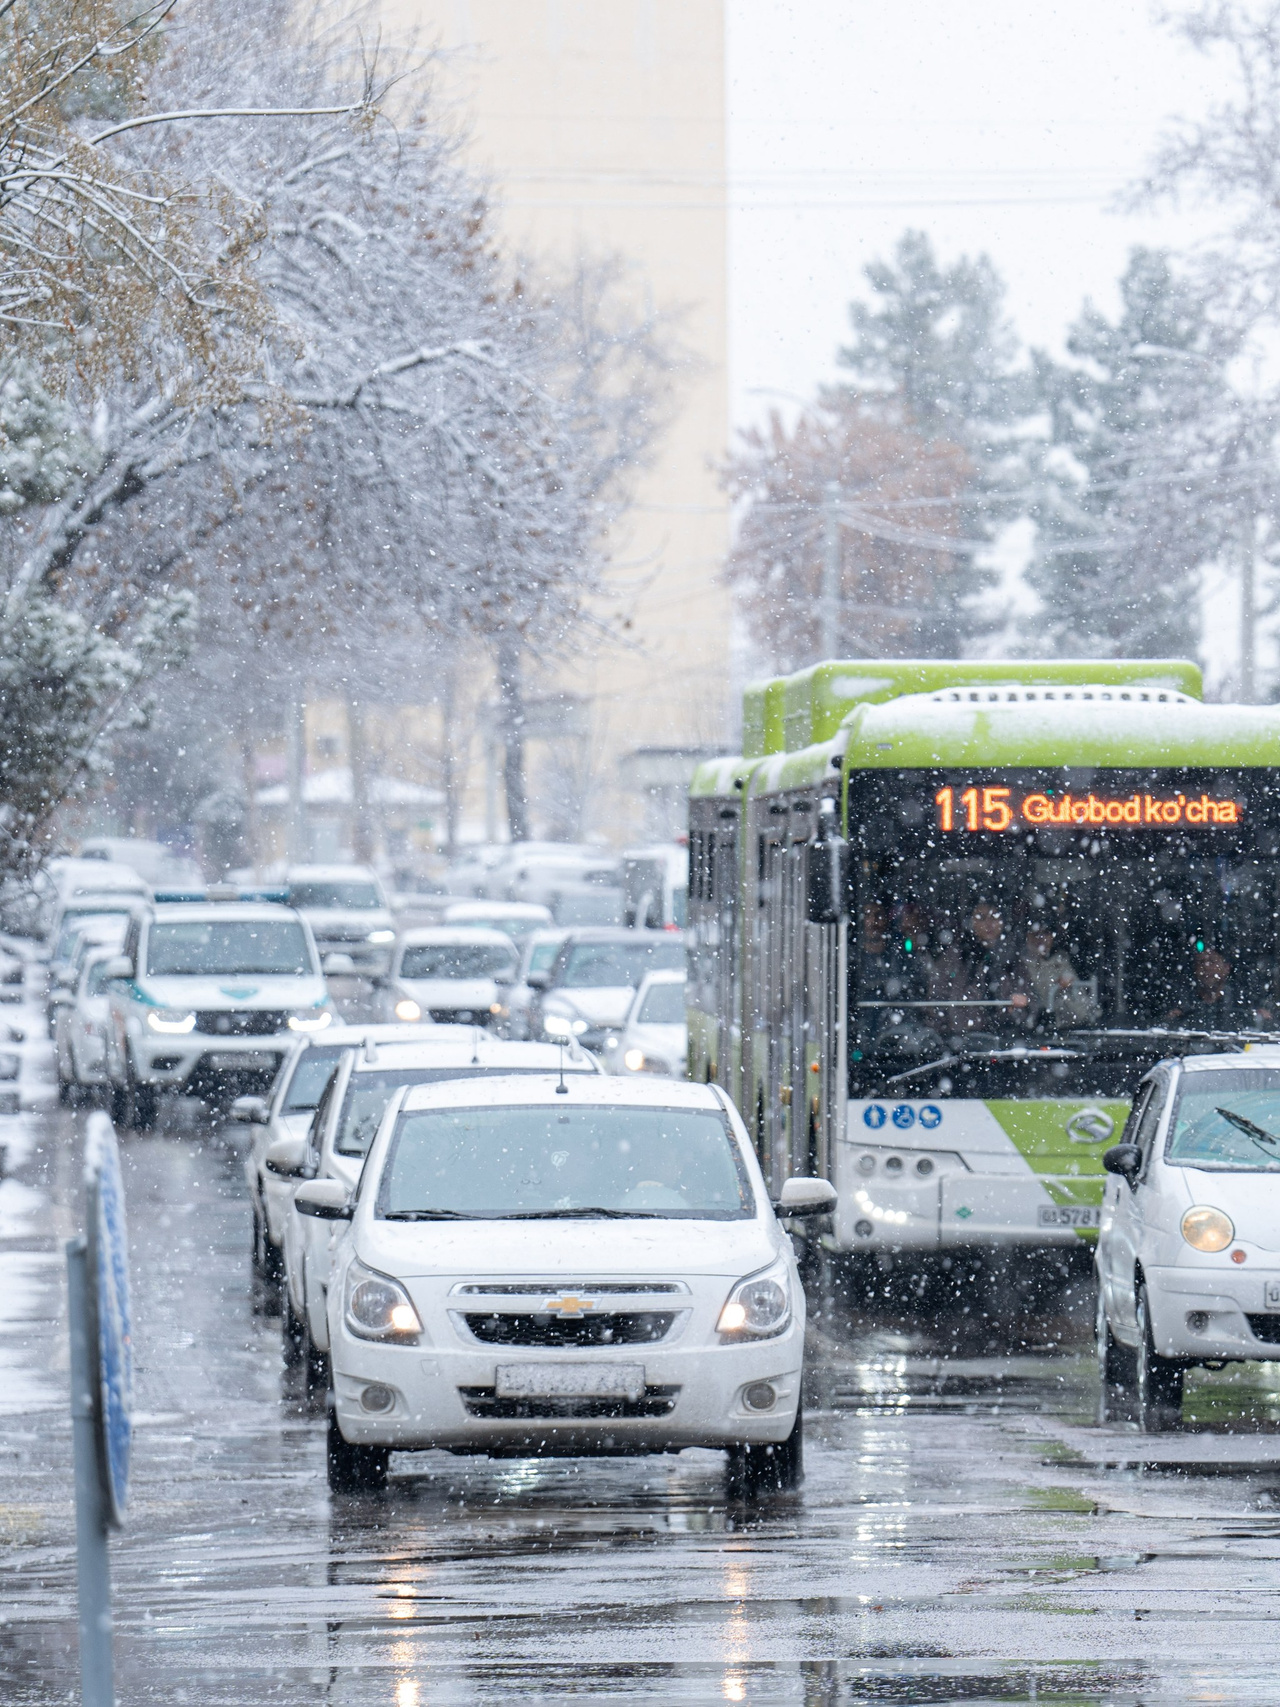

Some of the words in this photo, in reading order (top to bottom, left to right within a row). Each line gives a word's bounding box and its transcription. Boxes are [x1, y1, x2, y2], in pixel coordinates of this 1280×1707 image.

[935, 787, 1012, 831] 115
[1022, 794, 1141, 824] Gulobod
[1144, 794, 1238, 824] ko'cha
